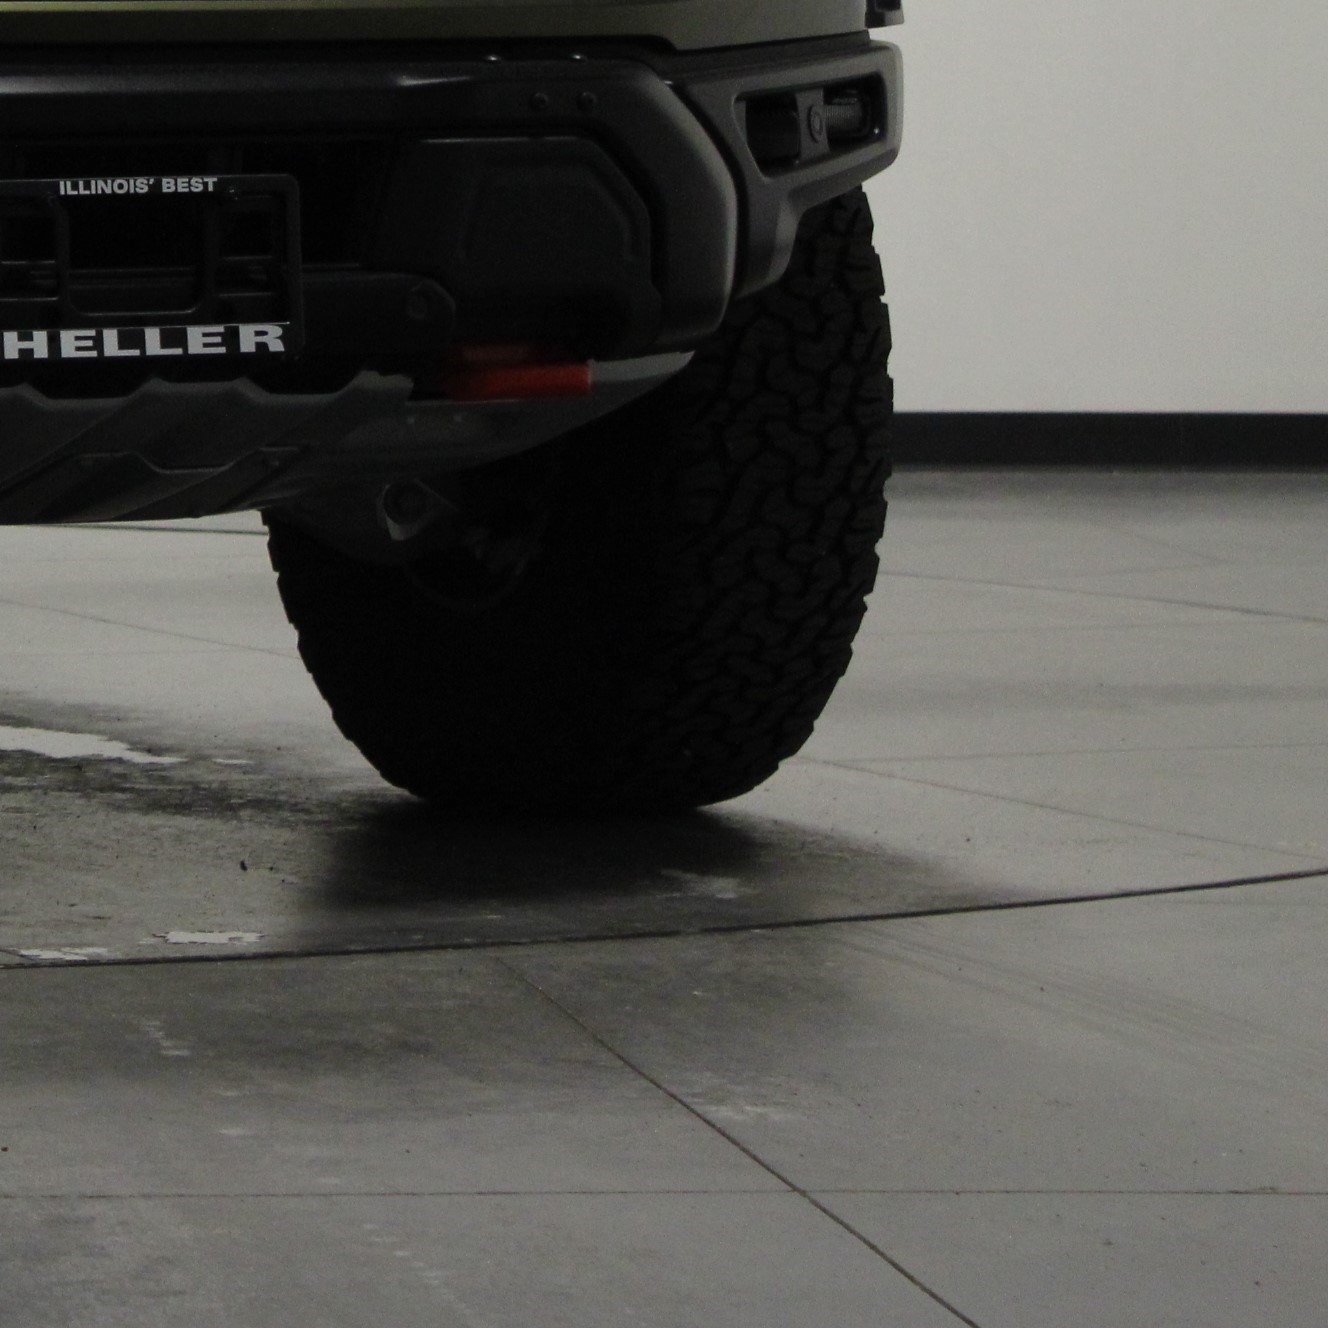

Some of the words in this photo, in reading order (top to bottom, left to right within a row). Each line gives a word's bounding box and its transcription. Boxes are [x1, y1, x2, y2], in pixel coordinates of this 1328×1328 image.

[58, 178, 155, 196] ILLINOIS'
[161, 177, 218, 193] BEST
[2, 324, 285, 360] HELLER
